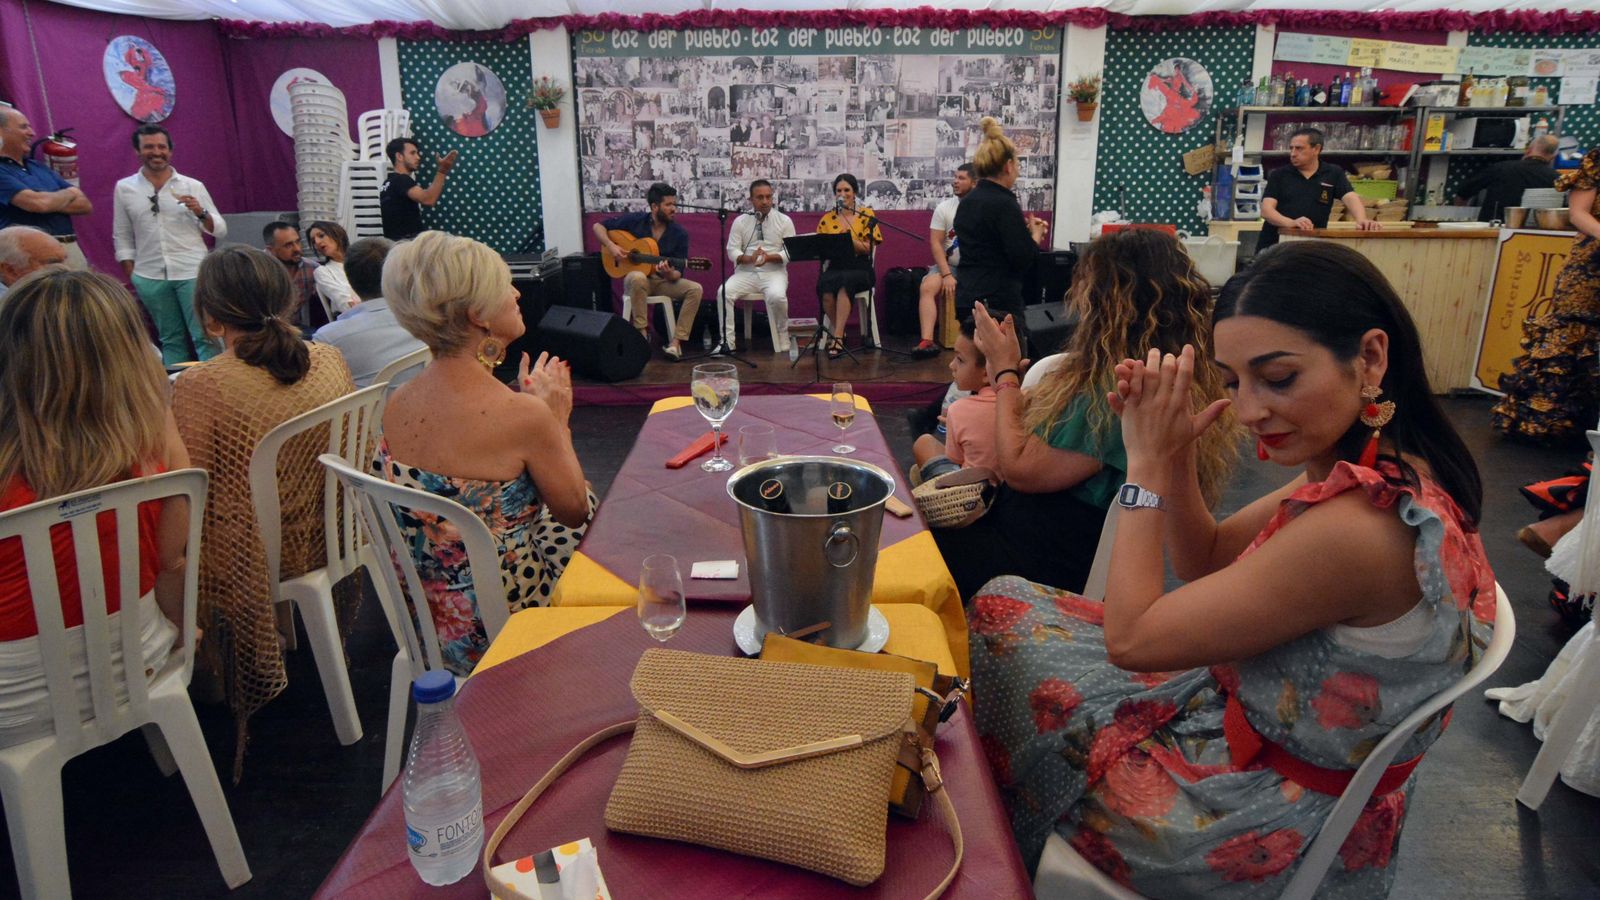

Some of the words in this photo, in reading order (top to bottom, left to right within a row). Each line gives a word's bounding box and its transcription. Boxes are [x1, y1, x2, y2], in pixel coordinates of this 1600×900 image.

[685, 28, 741, 51] pueblo
[788, 28, 817, 48] der
[825, 27, 882, 49] pueblo
[930, 28, 960, 47] der
[967, 27, 1024, 49] pueblo
[1501, 250, 1531, 330] Catering
